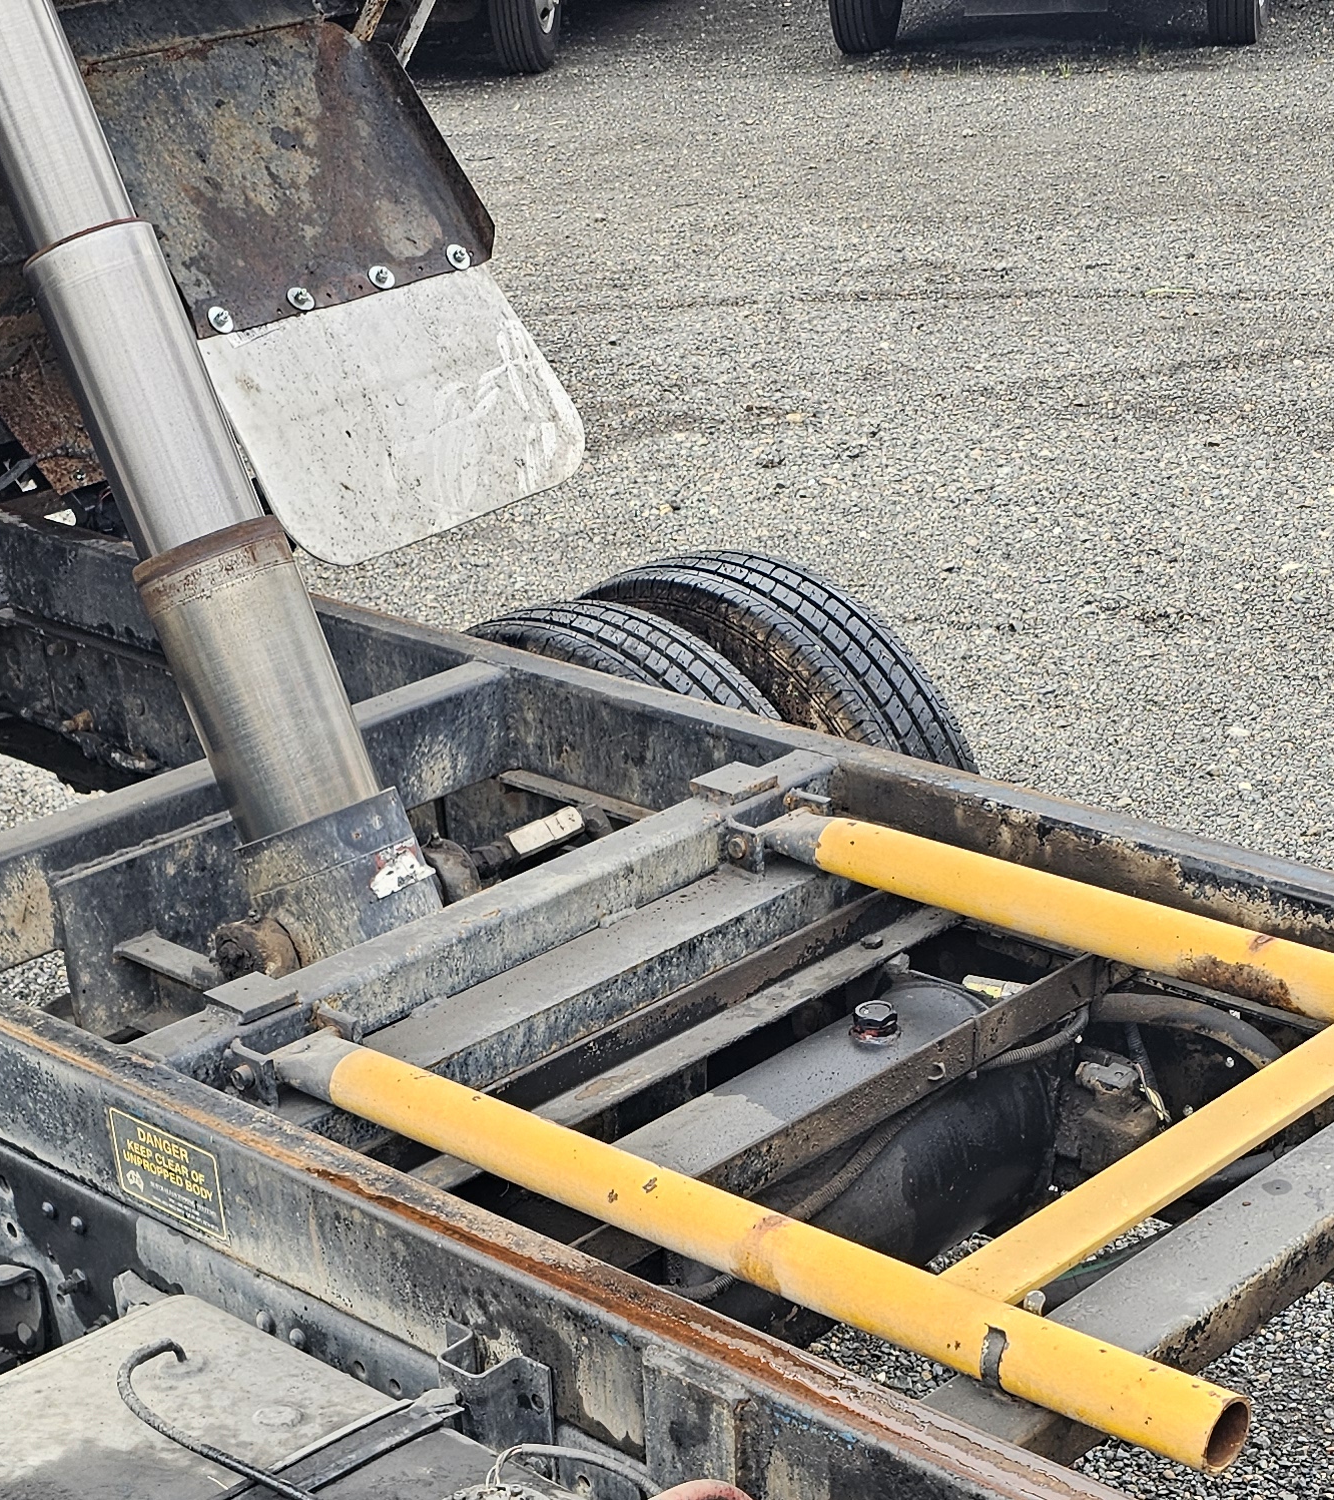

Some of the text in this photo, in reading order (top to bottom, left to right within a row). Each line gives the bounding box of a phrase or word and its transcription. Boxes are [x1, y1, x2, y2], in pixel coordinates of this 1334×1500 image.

[127, 1139, 205, 1185] KEEP CLEAR OF
[137, 1127, 189, 1163] DANGER
[123, 1149, 213, 1202] UNPROPPED BODY
